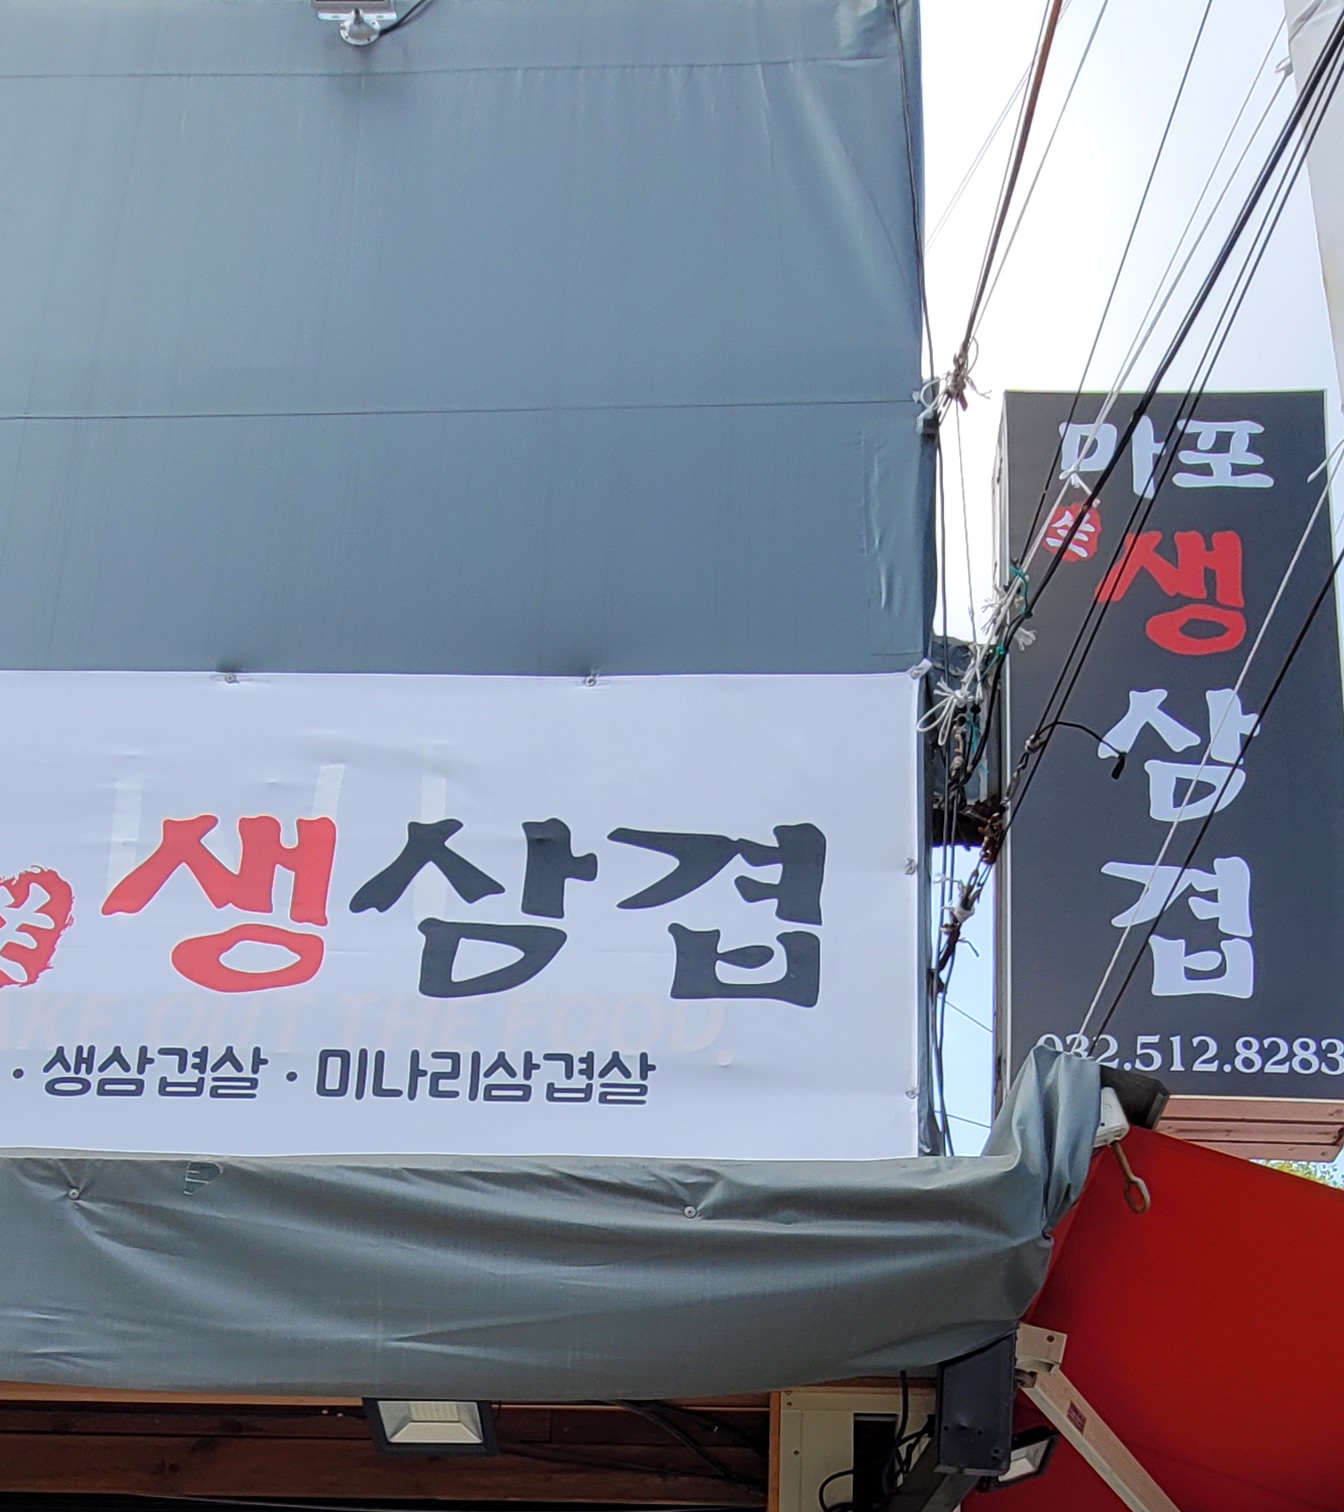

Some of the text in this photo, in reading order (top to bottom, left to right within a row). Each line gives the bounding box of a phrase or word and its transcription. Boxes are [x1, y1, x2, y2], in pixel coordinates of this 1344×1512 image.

[1058, 415, 1274, 499] 마포
[102, 813, 830, 1009] 생삼겹
[43, 1044, 267, 1101] 생삼겹살
[316, 1047, 656, 1105] 미나리삼겹살
